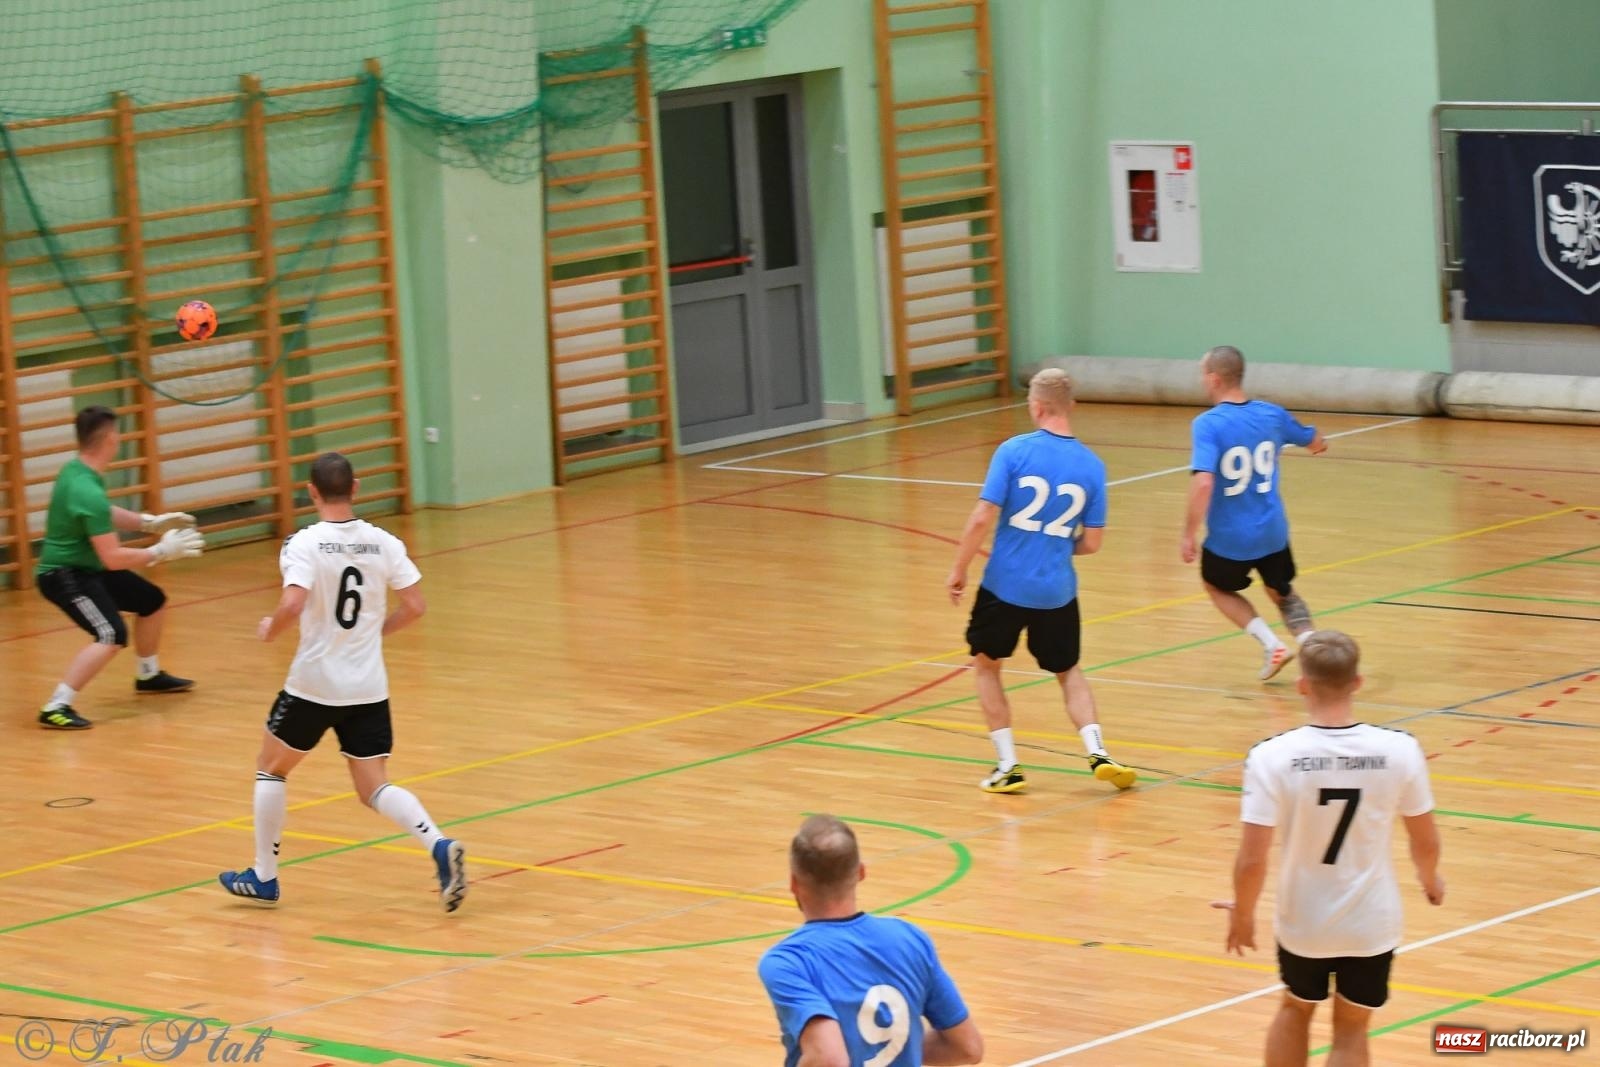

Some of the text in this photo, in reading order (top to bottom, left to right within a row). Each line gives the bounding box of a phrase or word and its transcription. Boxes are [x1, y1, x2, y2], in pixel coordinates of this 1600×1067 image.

[1220, 441, 1276, 497] 99
[1008, 475, 1087, 538] 22
[335, 565, 364, 630] 6
[1317, 788, 1362, 865] 7
[857, 984, 910, 1067] 9
